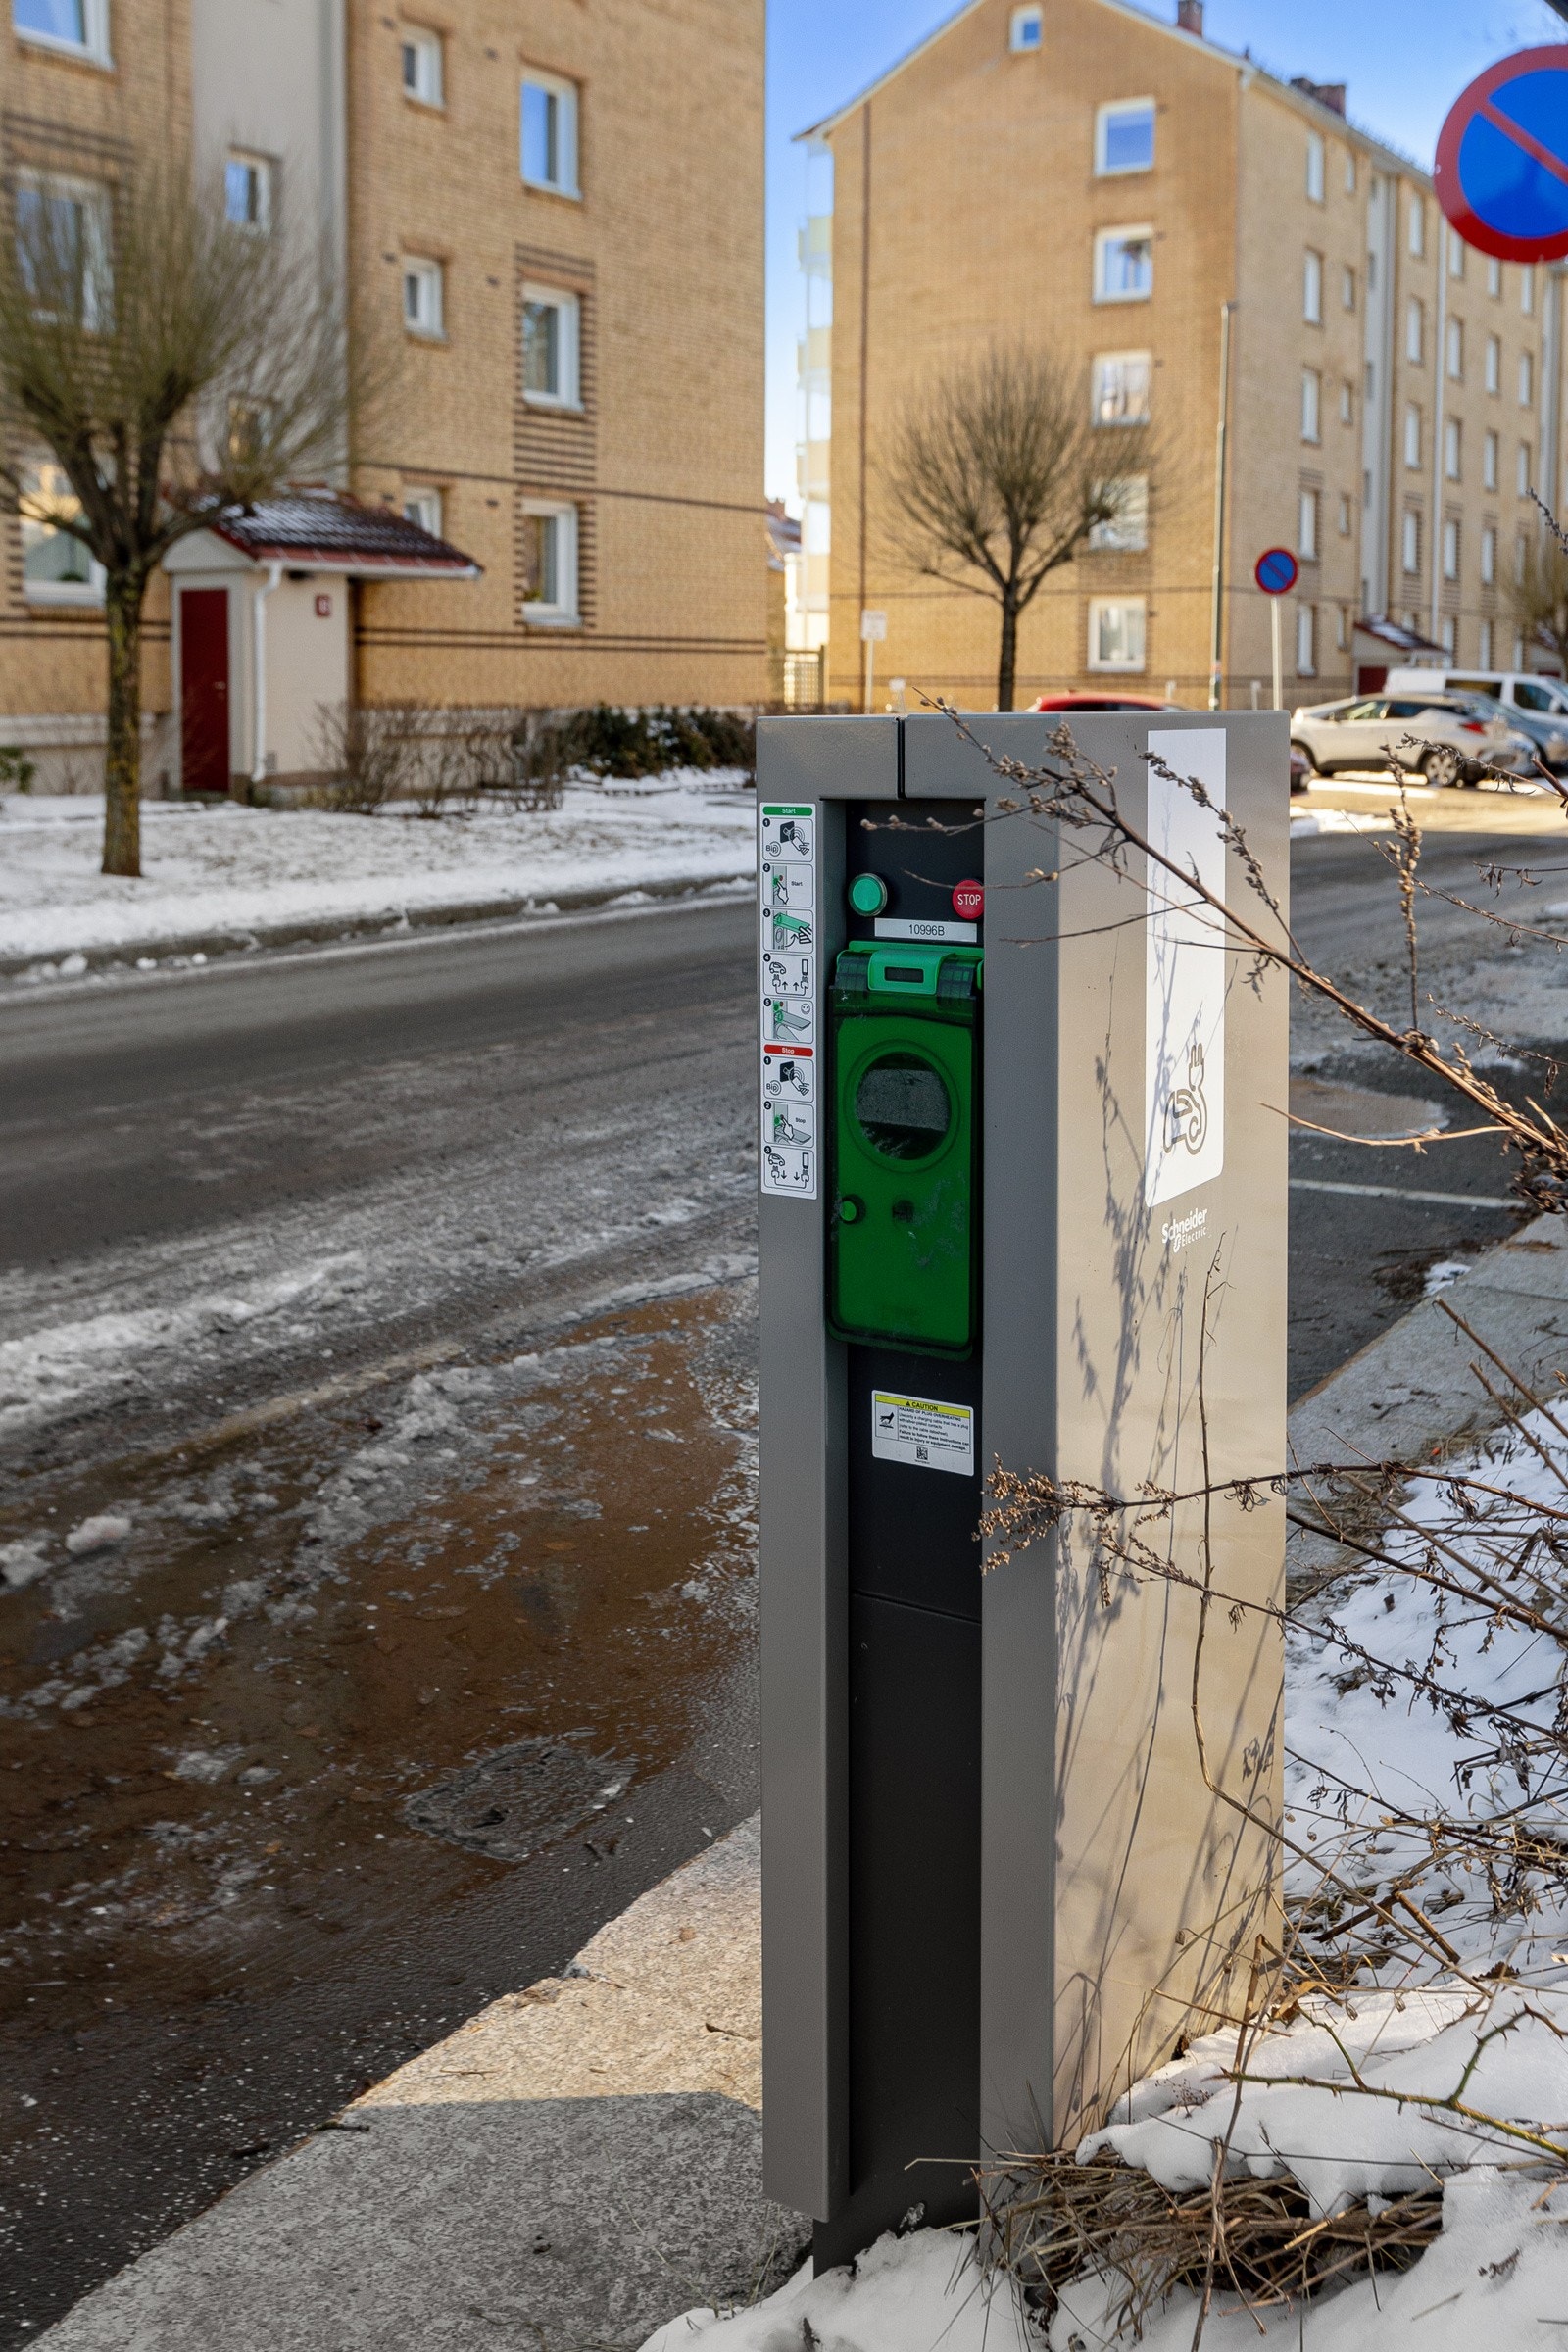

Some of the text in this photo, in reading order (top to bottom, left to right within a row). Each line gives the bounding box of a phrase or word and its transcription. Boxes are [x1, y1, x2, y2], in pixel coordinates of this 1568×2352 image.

[765, 845, 777, 854] Bip
[957, 894, 981, 906] STOP
[908, 924, 945, 936] 10996B
[766, 1083, 777, 1092] Bip
[1162, 1207, 1207, 1243] Schneider
[1182, 1226, 1206, 1247] Electric
[911, 1401, 938, 1411] CAUTION
